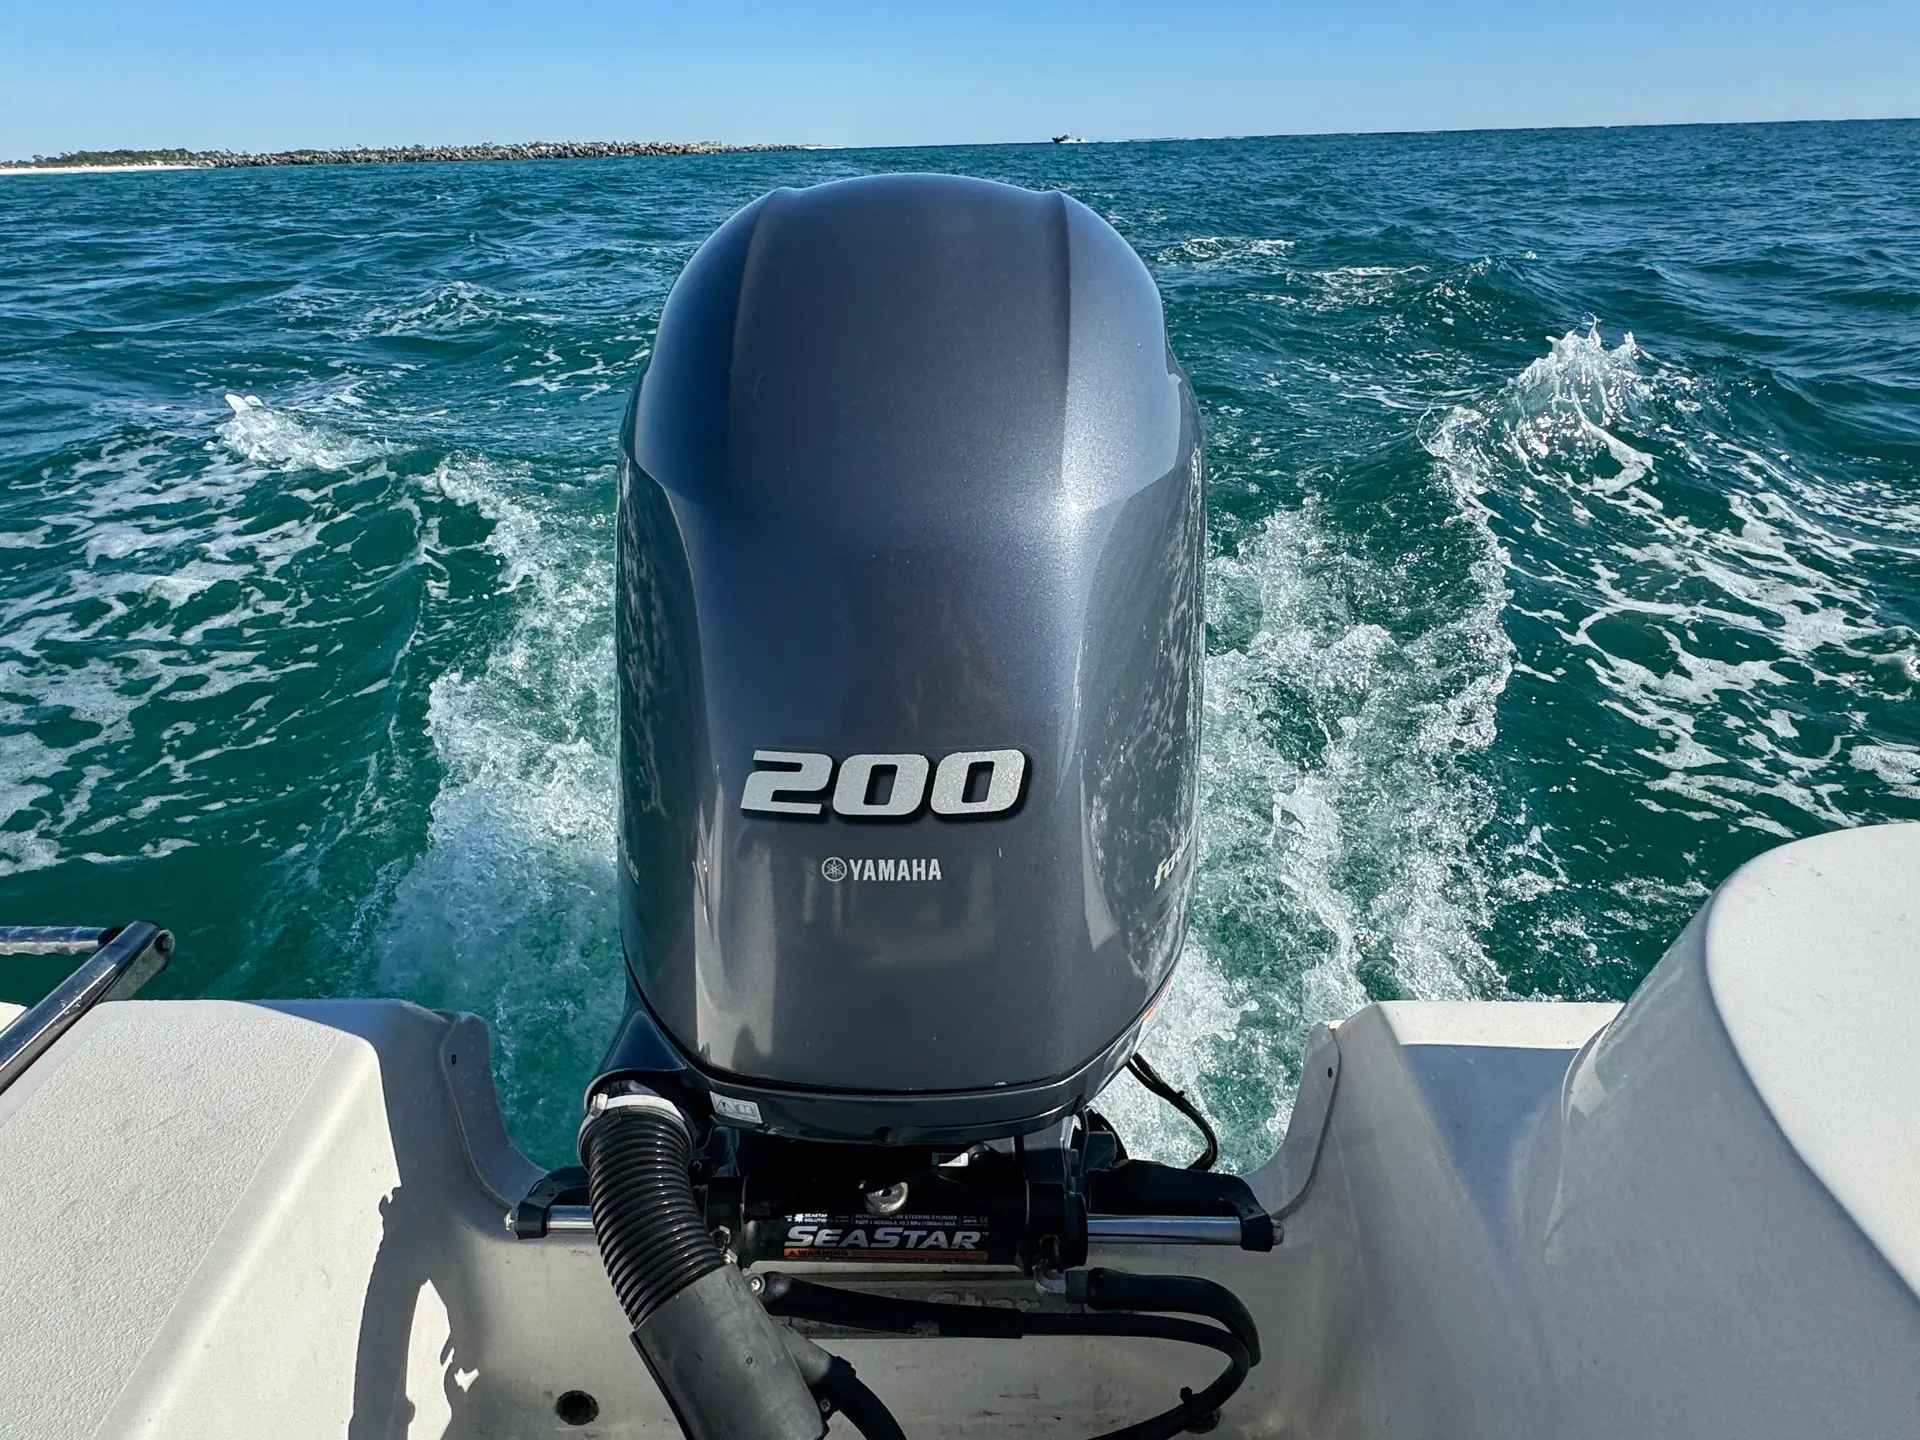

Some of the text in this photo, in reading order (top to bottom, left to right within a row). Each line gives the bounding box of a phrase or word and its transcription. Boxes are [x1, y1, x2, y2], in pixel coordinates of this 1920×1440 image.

[741, 749, 1026, 816] 200
[849, 858, 942, 882] YAMAHA
[798, 1249, 847, 1257] WARNING
